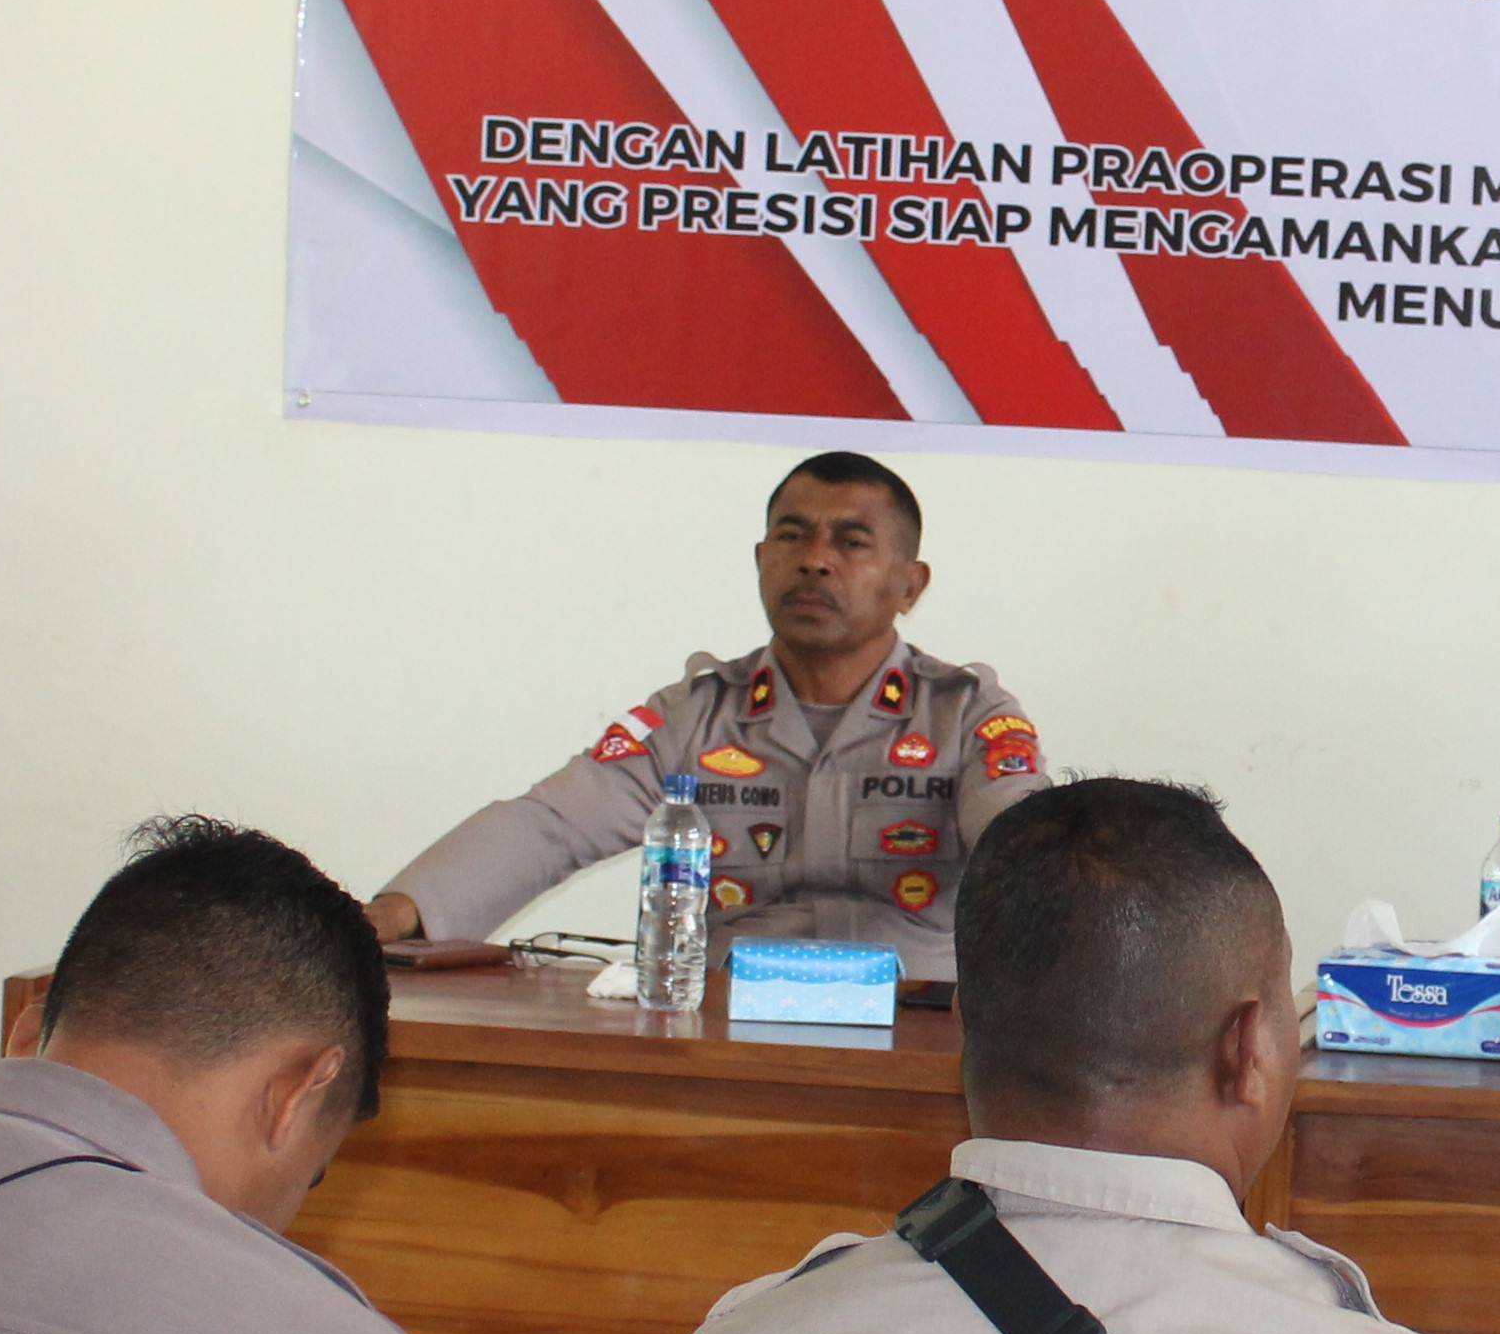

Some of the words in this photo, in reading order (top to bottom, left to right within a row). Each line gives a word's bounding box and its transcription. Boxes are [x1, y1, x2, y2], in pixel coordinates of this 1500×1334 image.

[484, 118, 746, 171] DENGAN
[766, 131, 1032, 185] LATIHAN
[1051, 145, 1453, 206] PRAOPERASI
[452, 177, 625, 226] YANG
[641, 187, 872, 238] PRESISI
[891, 198, 1031, 245] SIAP
[862, 775, 954, 800] POLRI
[1386, 974, 1448, 1005] Tessa
